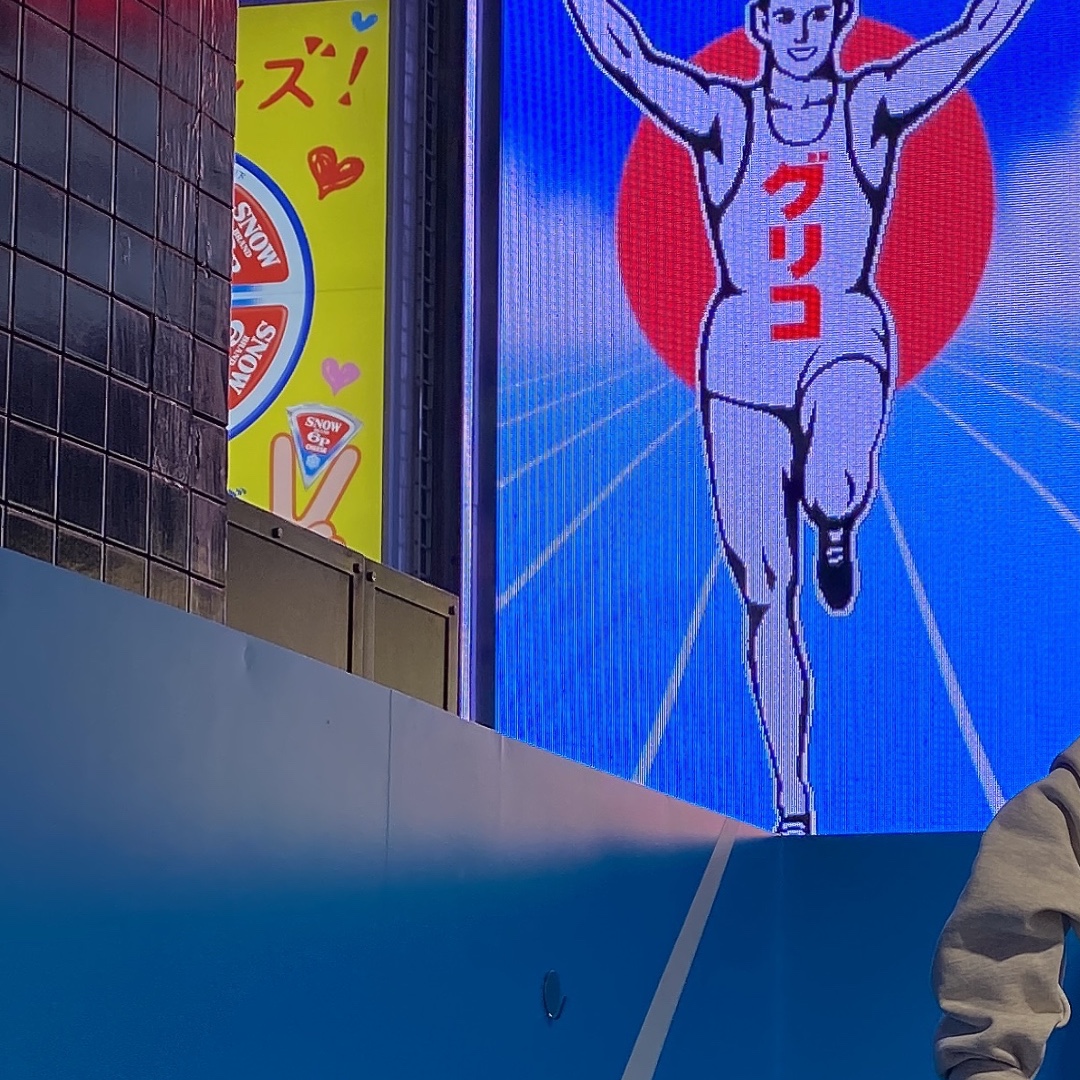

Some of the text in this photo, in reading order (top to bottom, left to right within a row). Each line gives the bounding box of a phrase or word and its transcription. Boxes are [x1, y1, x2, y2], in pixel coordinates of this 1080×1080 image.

[235, 36, 369, 110] ズ!
[232, 202, 282, 268] SNOW
[763, 151, 829, 342] グリコ
[228, 320, 277, 396] SNOW
[304, 416, 342, 433] SNOW
